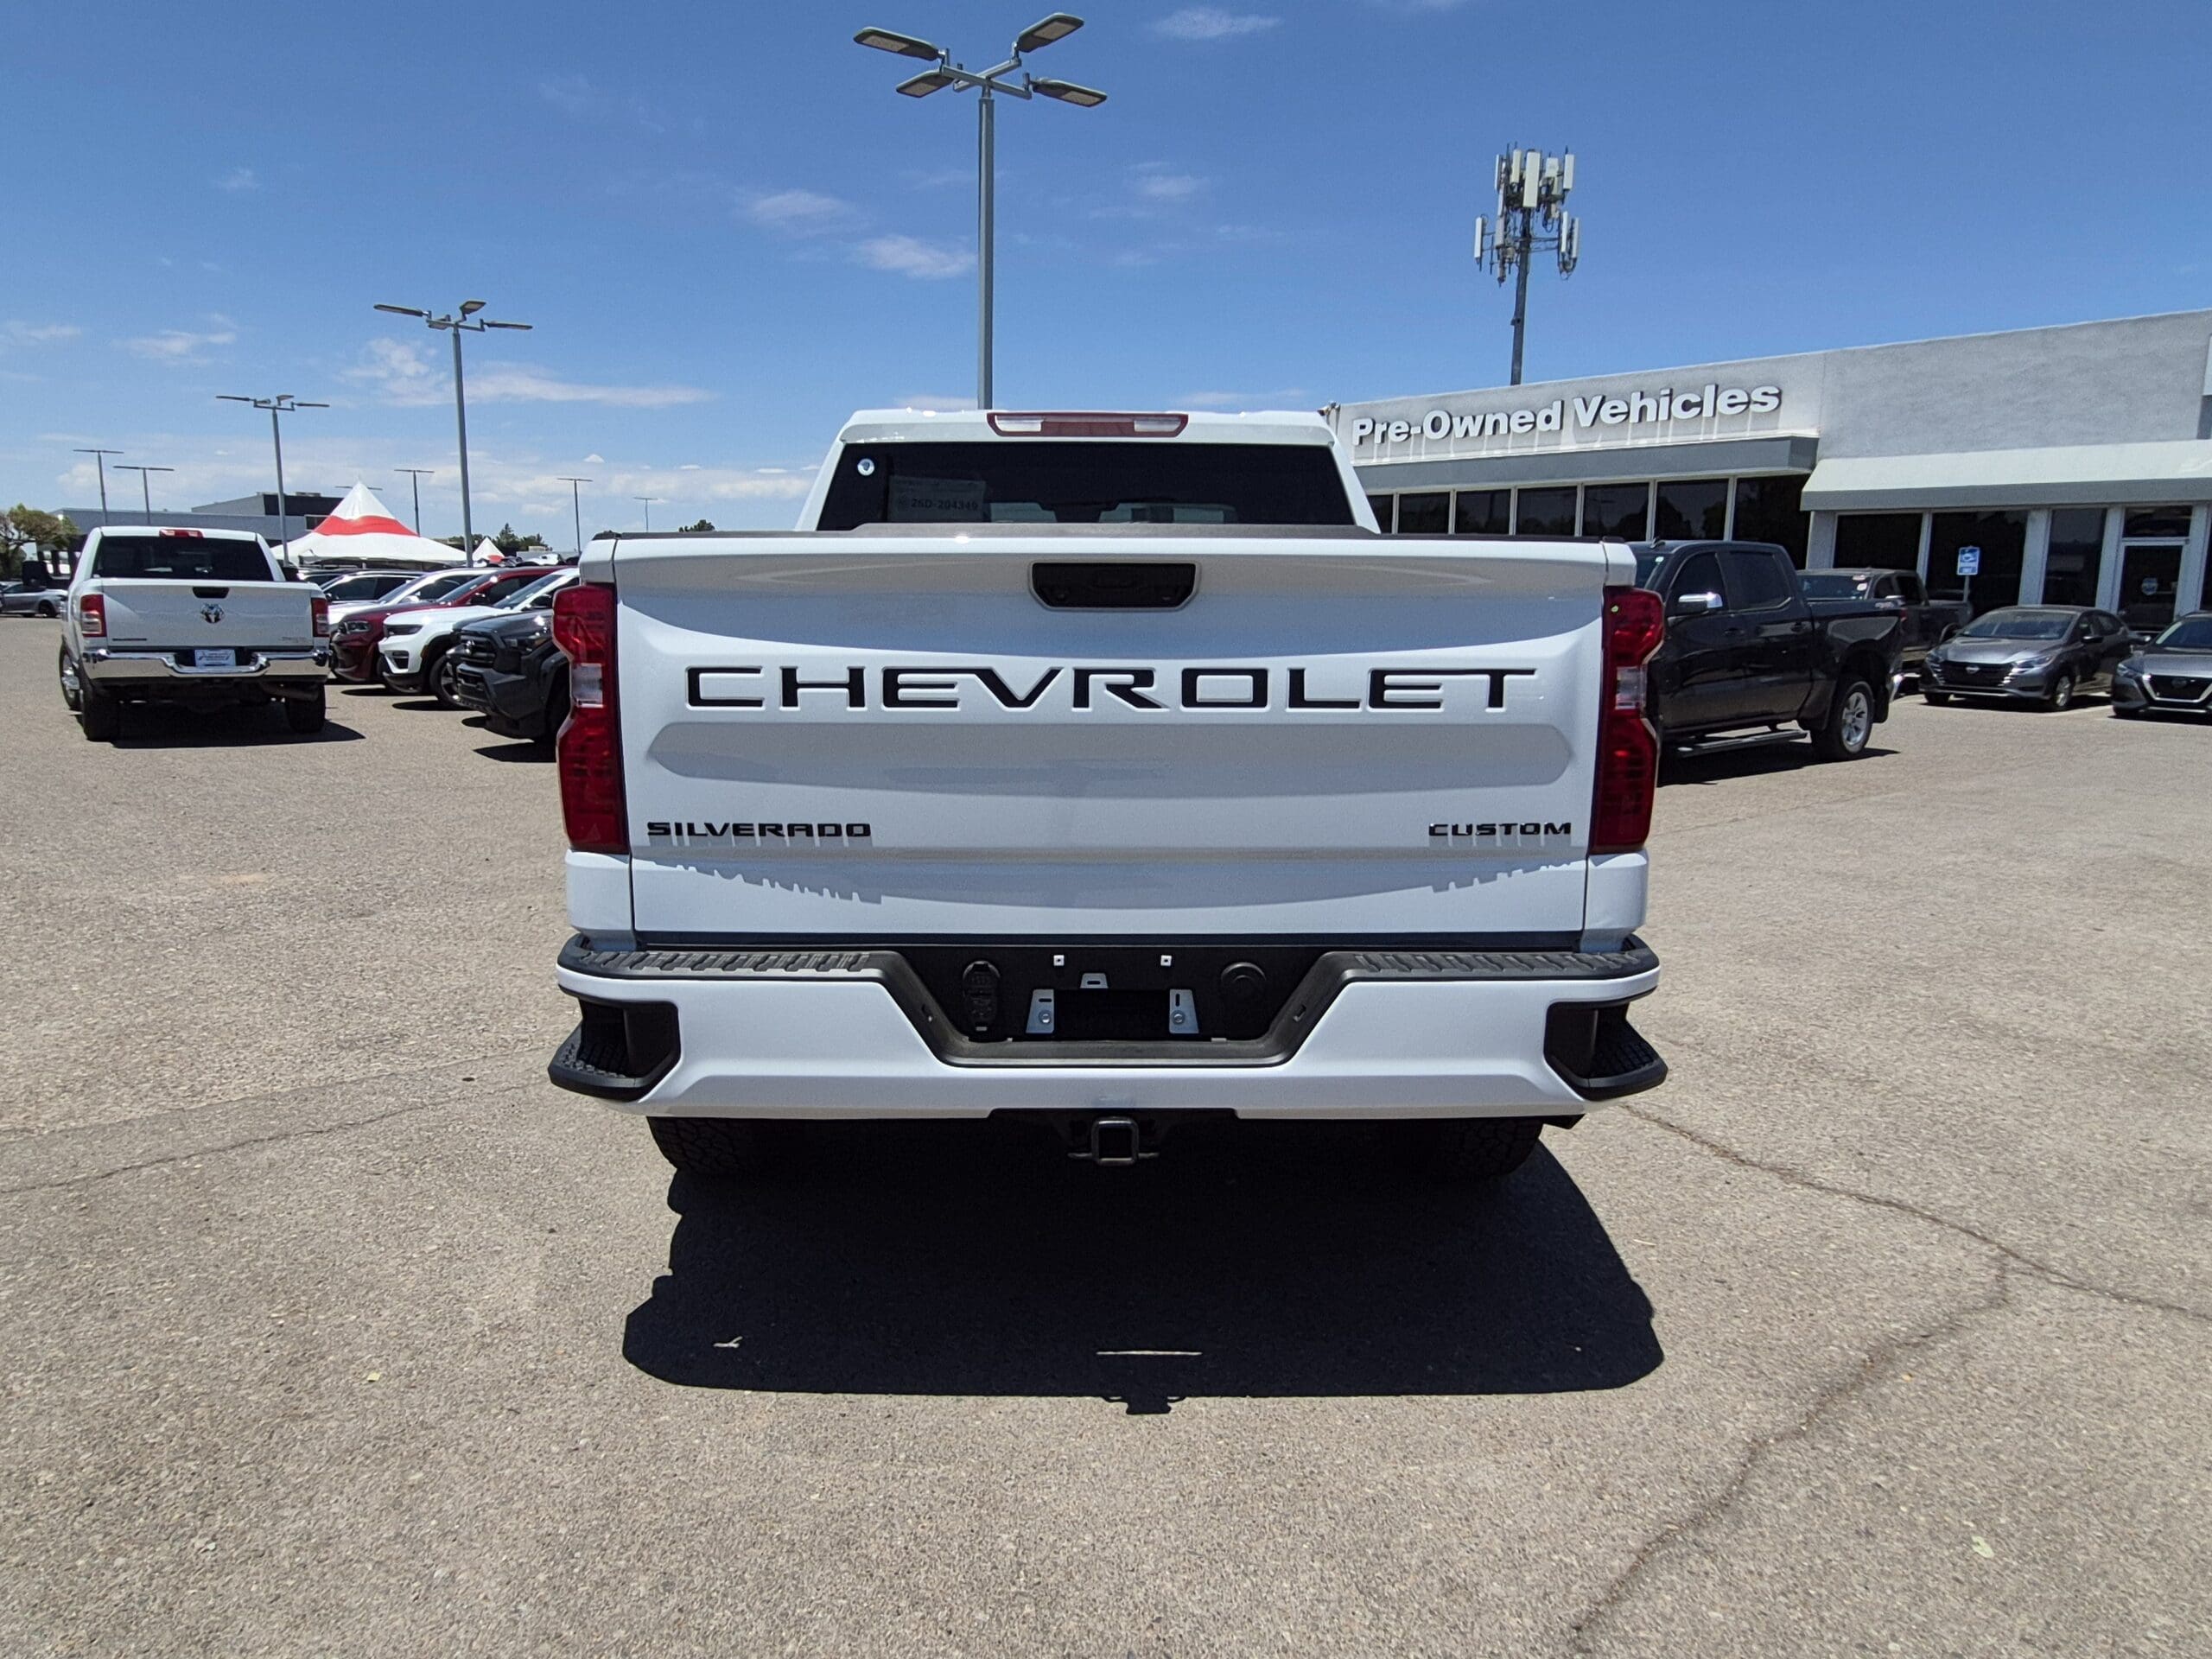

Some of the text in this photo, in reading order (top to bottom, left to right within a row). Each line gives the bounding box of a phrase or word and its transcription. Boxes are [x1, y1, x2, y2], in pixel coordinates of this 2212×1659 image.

[1351, 384, 1782, 445] Pre-Owned Vehicles
[683, 666, 1537, 709] CHEVROLET
[646, 822, 872, 837] SILVERADO
[1428, 822, 1573, 836] CUSTOM
